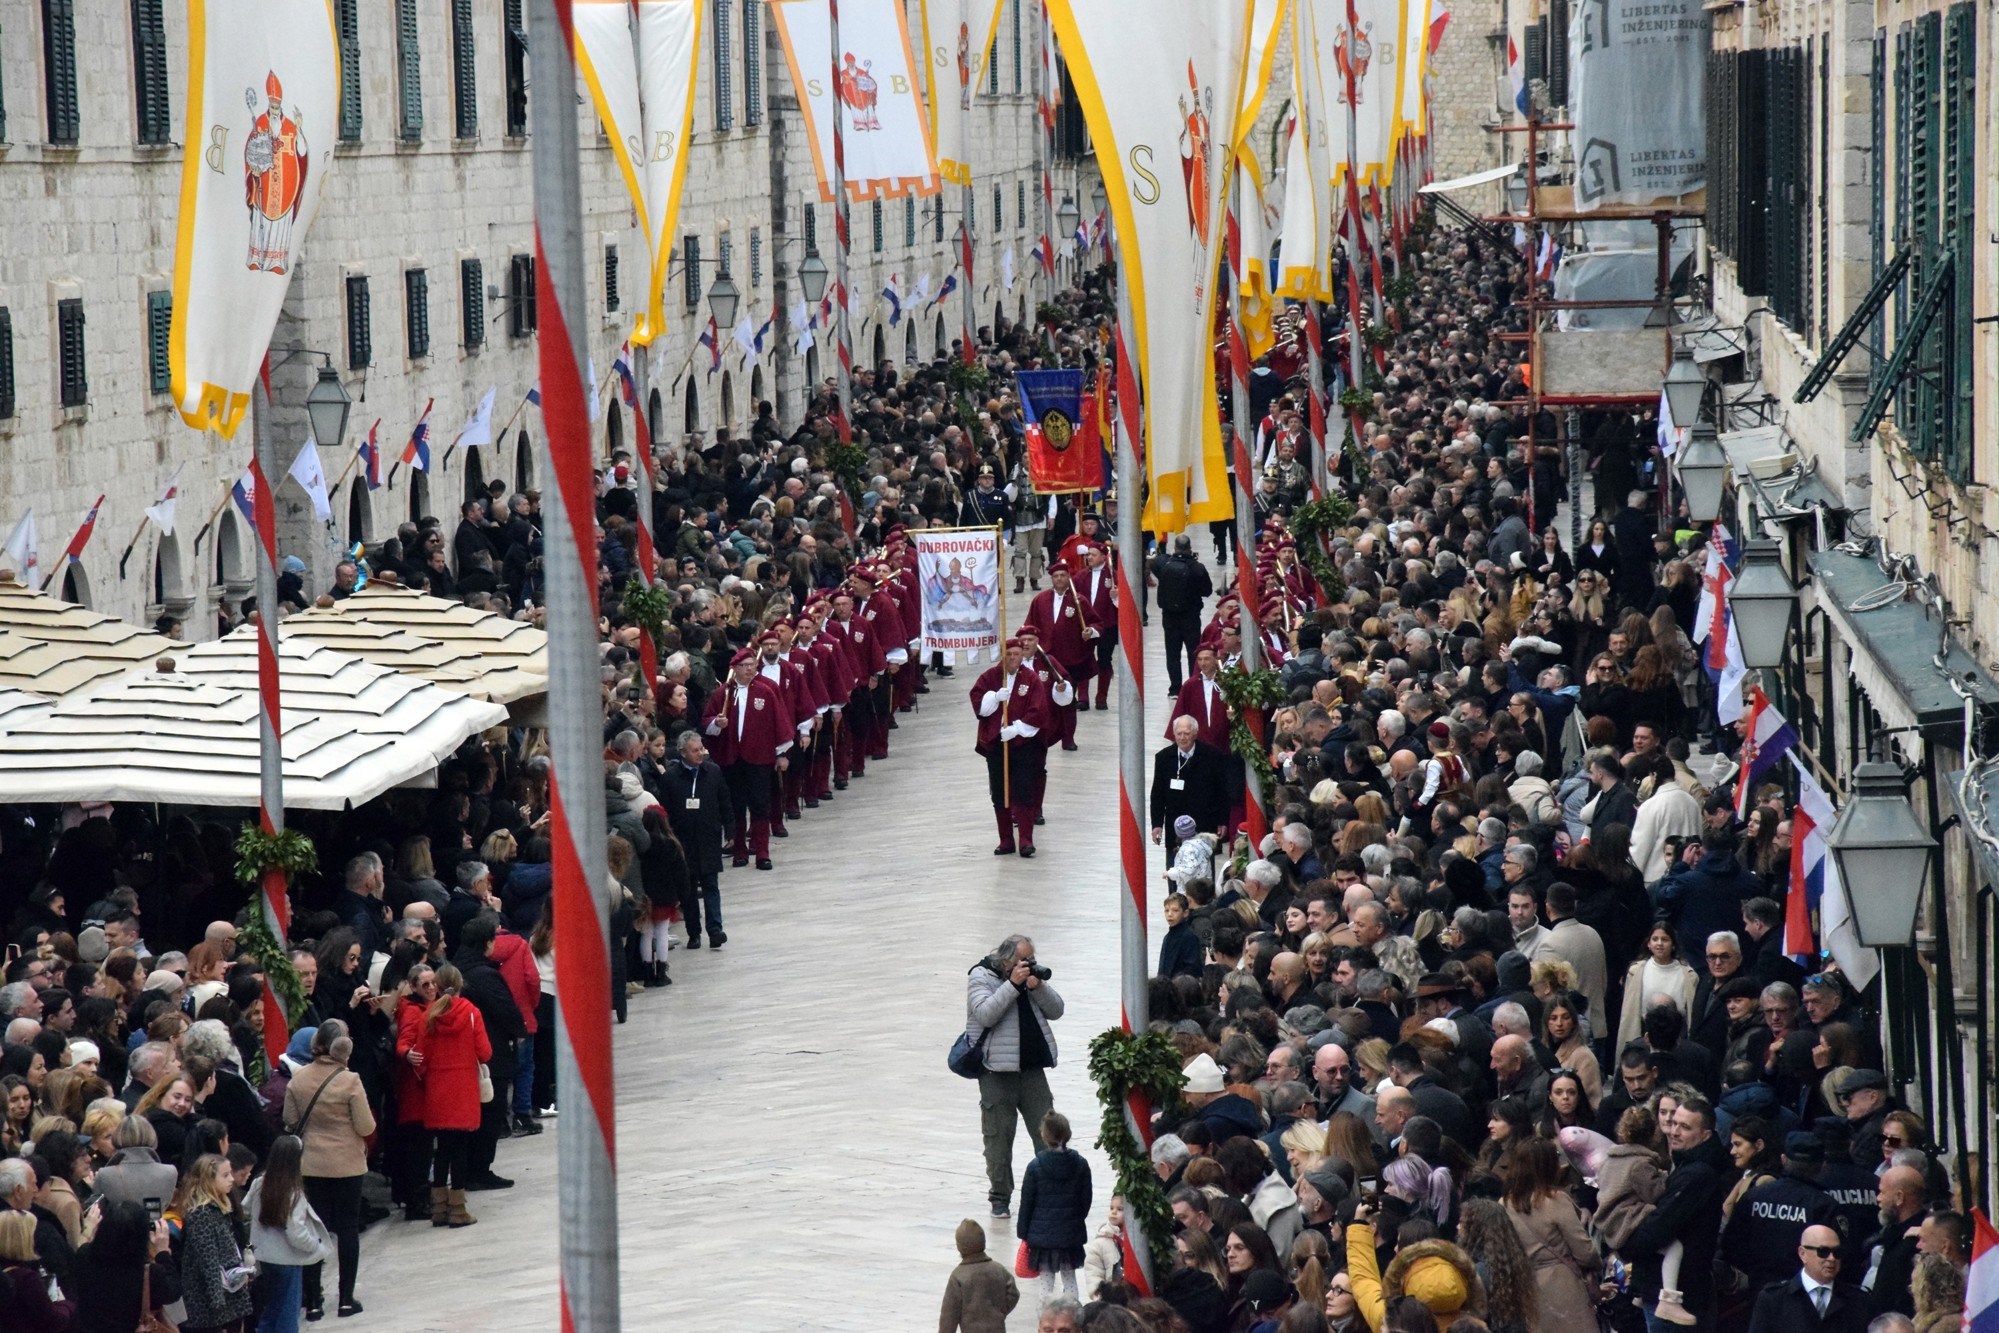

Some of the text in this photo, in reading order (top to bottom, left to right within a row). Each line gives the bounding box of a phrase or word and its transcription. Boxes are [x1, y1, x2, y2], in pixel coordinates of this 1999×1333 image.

[1621, 4, 1687, 18] LIBERTAS
[1622, 18, 1708, 34] INŽENJERING
[934, 46, 982, 74] S B
[1379, 42, 1395, 65] B
[807, 75, 910, 98] S B
[627, 130, 675, 168] S B
[1630, 148, 1696, 163] LIBERTAS
[1129, 144, 1161, 205] S
[919, 537, 994, 554] DUBROVAČKI
[925, 634, 997, 649] TROMBUNJERI
[1824, 1188, 1878, 1206] OLICIJA
[1751, 1201, 1807, 1224] POLICIJA
